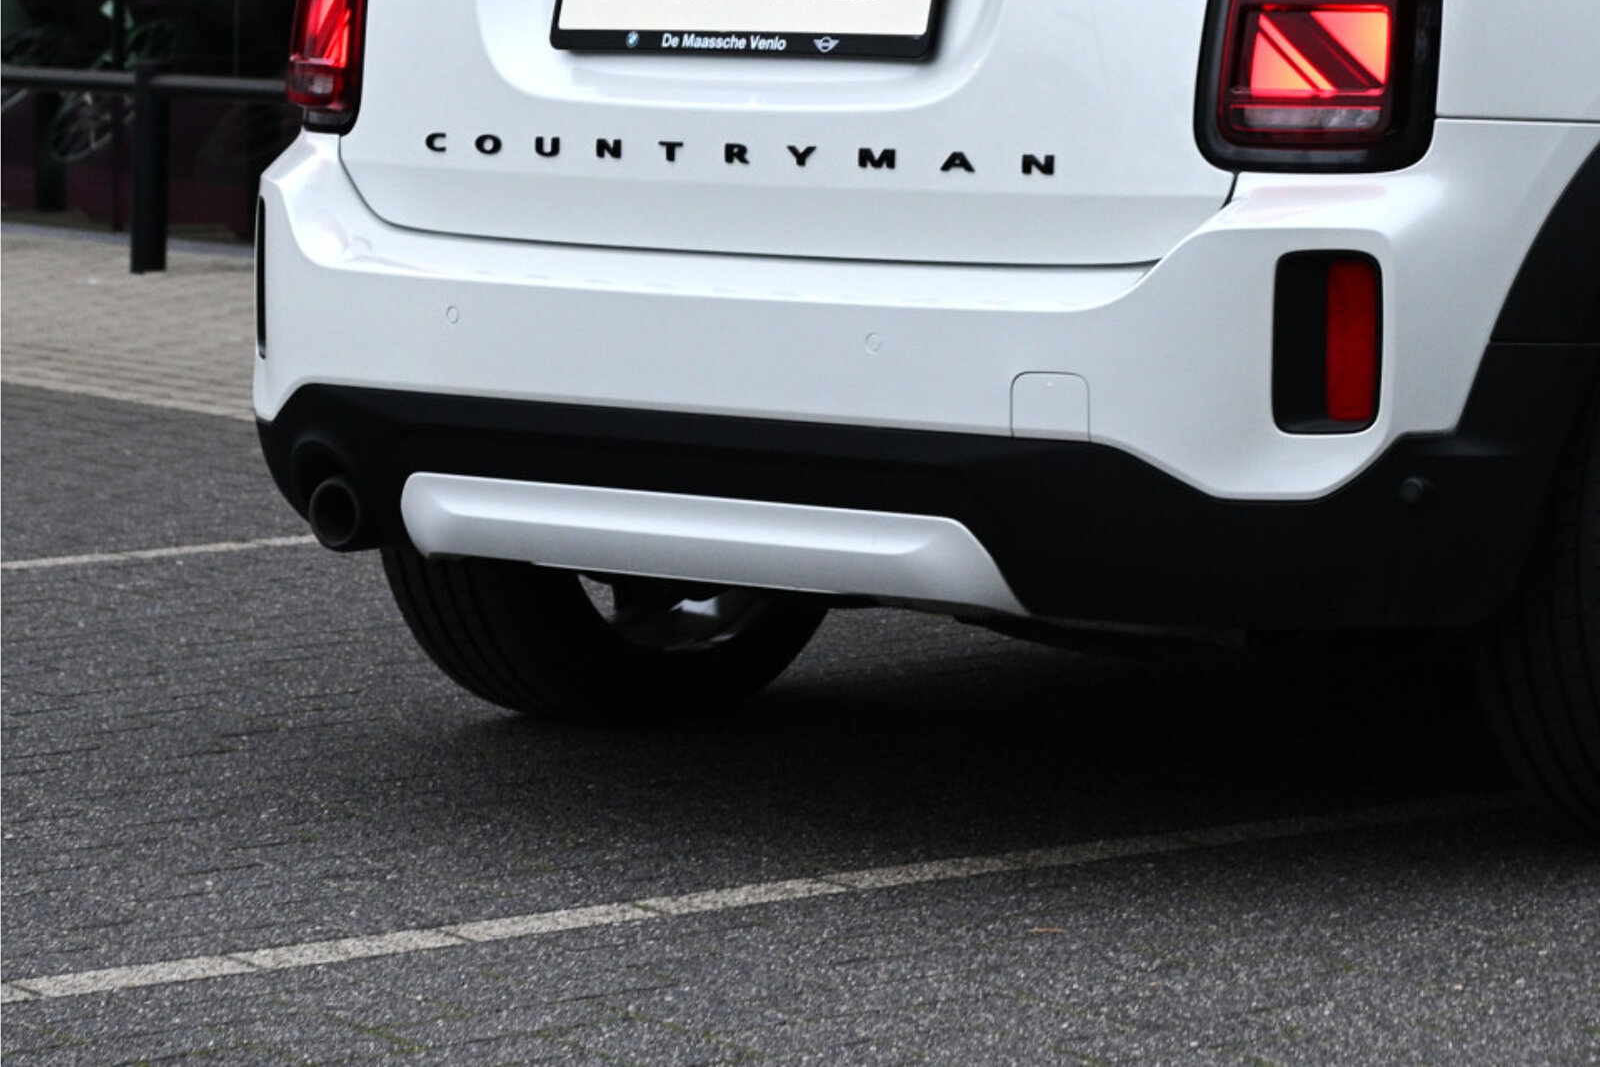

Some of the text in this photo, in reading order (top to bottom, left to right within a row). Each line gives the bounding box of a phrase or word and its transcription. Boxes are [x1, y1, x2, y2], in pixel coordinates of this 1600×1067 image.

[661, 33, 787, 51] De Maassche Venlo
[425, 131, 1056, 176] COUNTRYMAN
